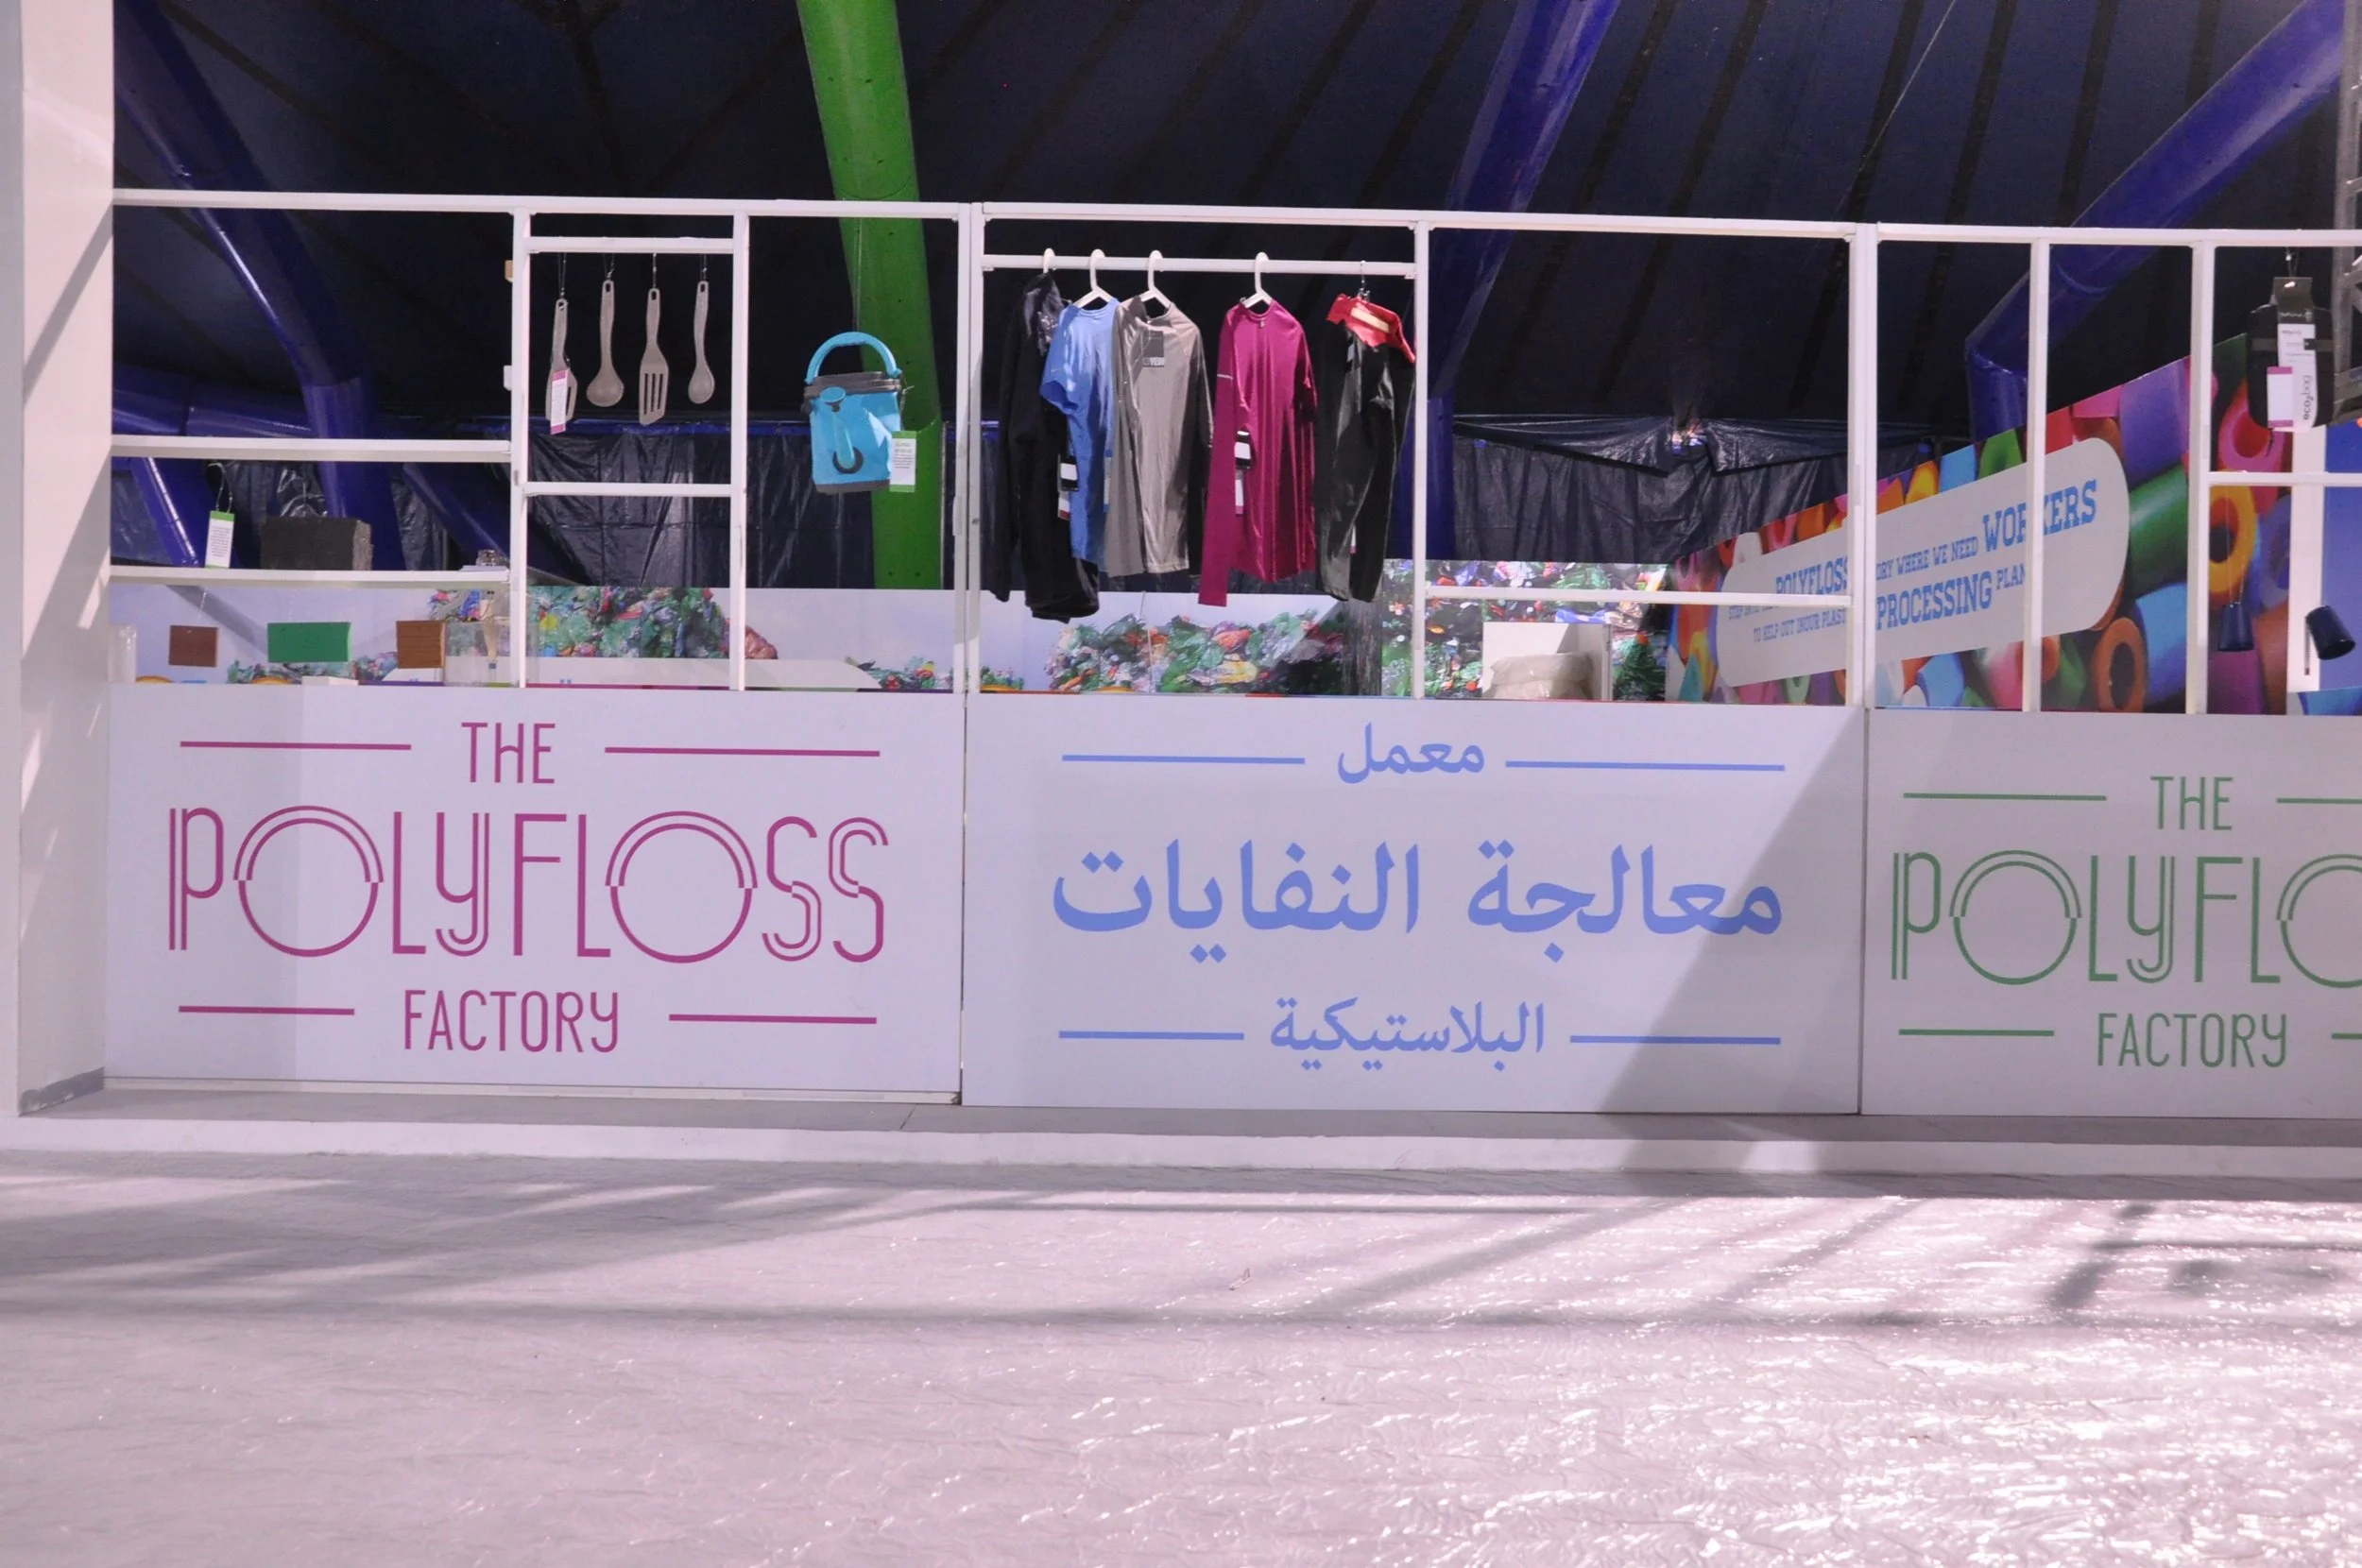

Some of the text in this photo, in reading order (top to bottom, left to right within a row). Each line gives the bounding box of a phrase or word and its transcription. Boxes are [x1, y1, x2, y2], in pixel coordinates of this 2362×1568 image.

[1896, 549, 1929, 575] WHERE
[1932, 544, 1948, 566] WE
[1951, 536, 1978, 562] NEED
[1875, 571, 1993, 630] PROCESSING
[461, 722, 556, 785] THE
[1337, 724, 1486, 785] معمل
[2149, 776, 2234, 830] THE
[168, 805, 890, 964] POLYFLOSS
[1052, 839, 1783, 963] معالجة النفايات
[403, 989, 620, 1054] FACTORY
[1269, 996, 1546, 1071] البلاستيكية
[2097, 1012, 2287, 1068] FACTORY
